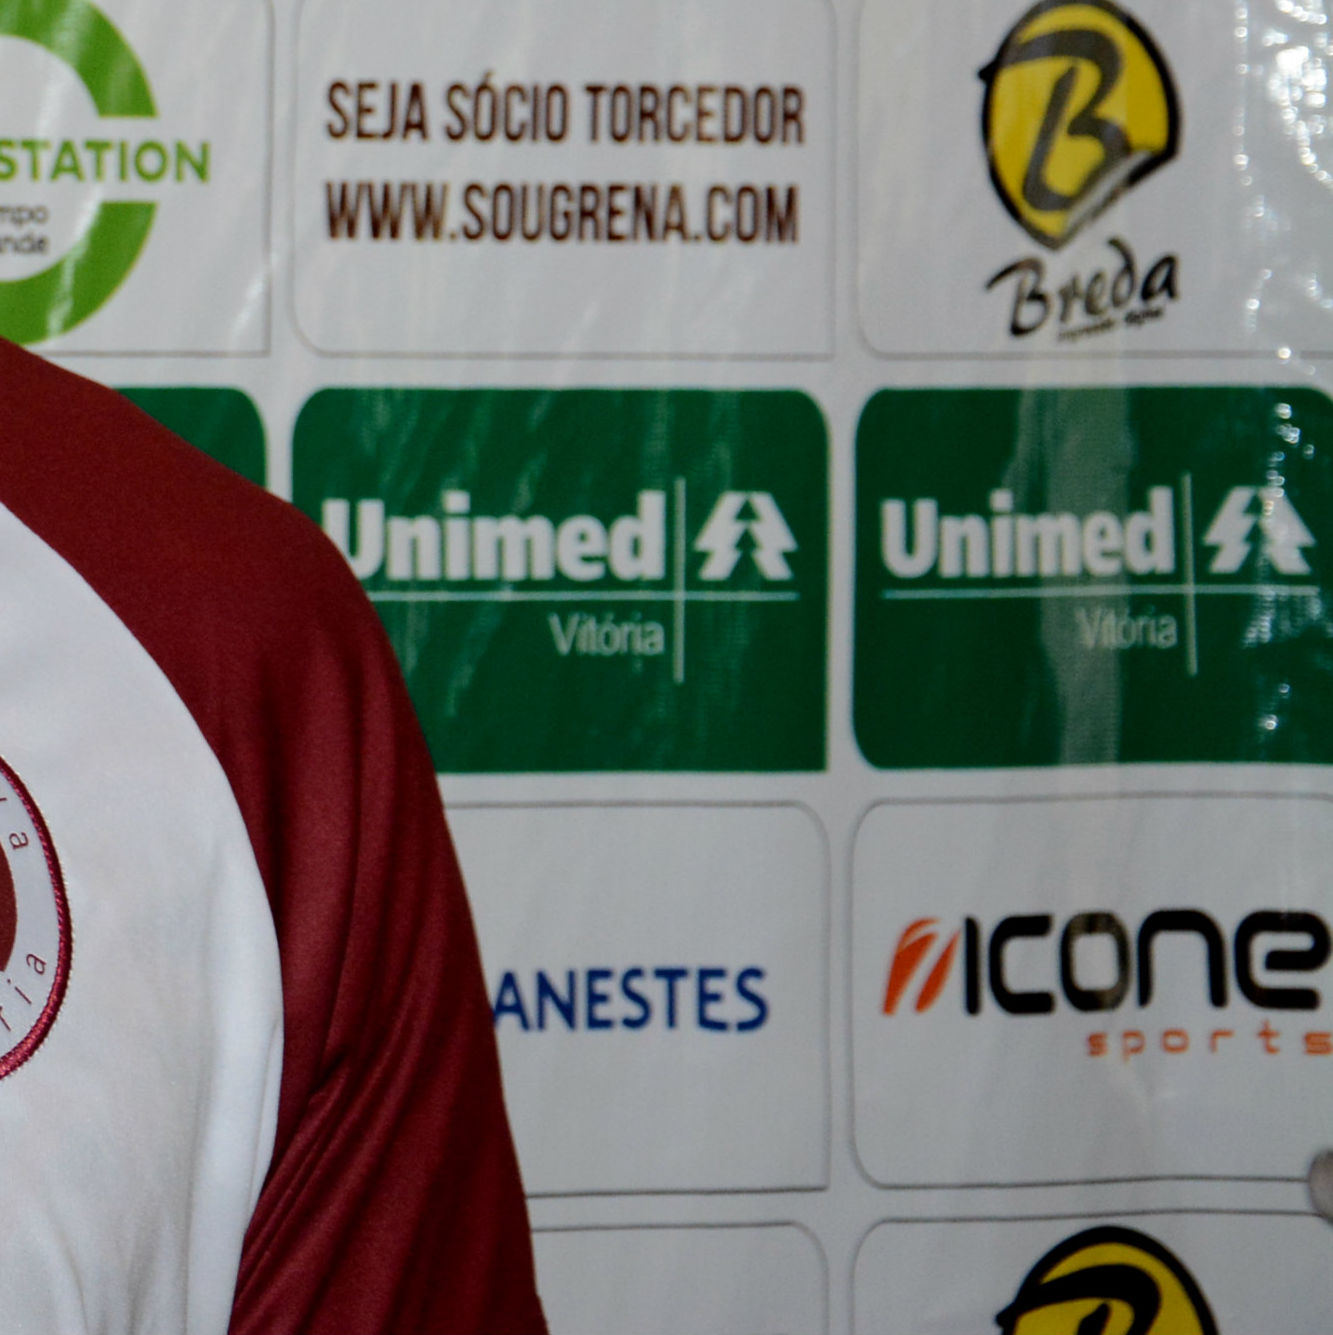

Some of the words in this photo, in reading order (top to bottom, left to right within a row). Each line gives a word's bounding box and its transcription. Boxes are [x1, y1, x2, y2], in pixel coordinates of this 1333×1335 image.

[326, 81, 430, 143] SEJA
[445, 70, 570, 144] SÓCIO
[585, 84, 805, 146] TORCEDOR
[326, 181, 800, 245] WWW.SOUGRENA.COM
[985, 234, 1179, 338] Breda
[323, 490, 667, 581] Unimed
[880, 486, 1176, 579] Unimed
[549, 613, 666, 657] Vitória
[1078, 607, 1178, 651] Vitória
[1086, 1019, 1333, 1063] sports
